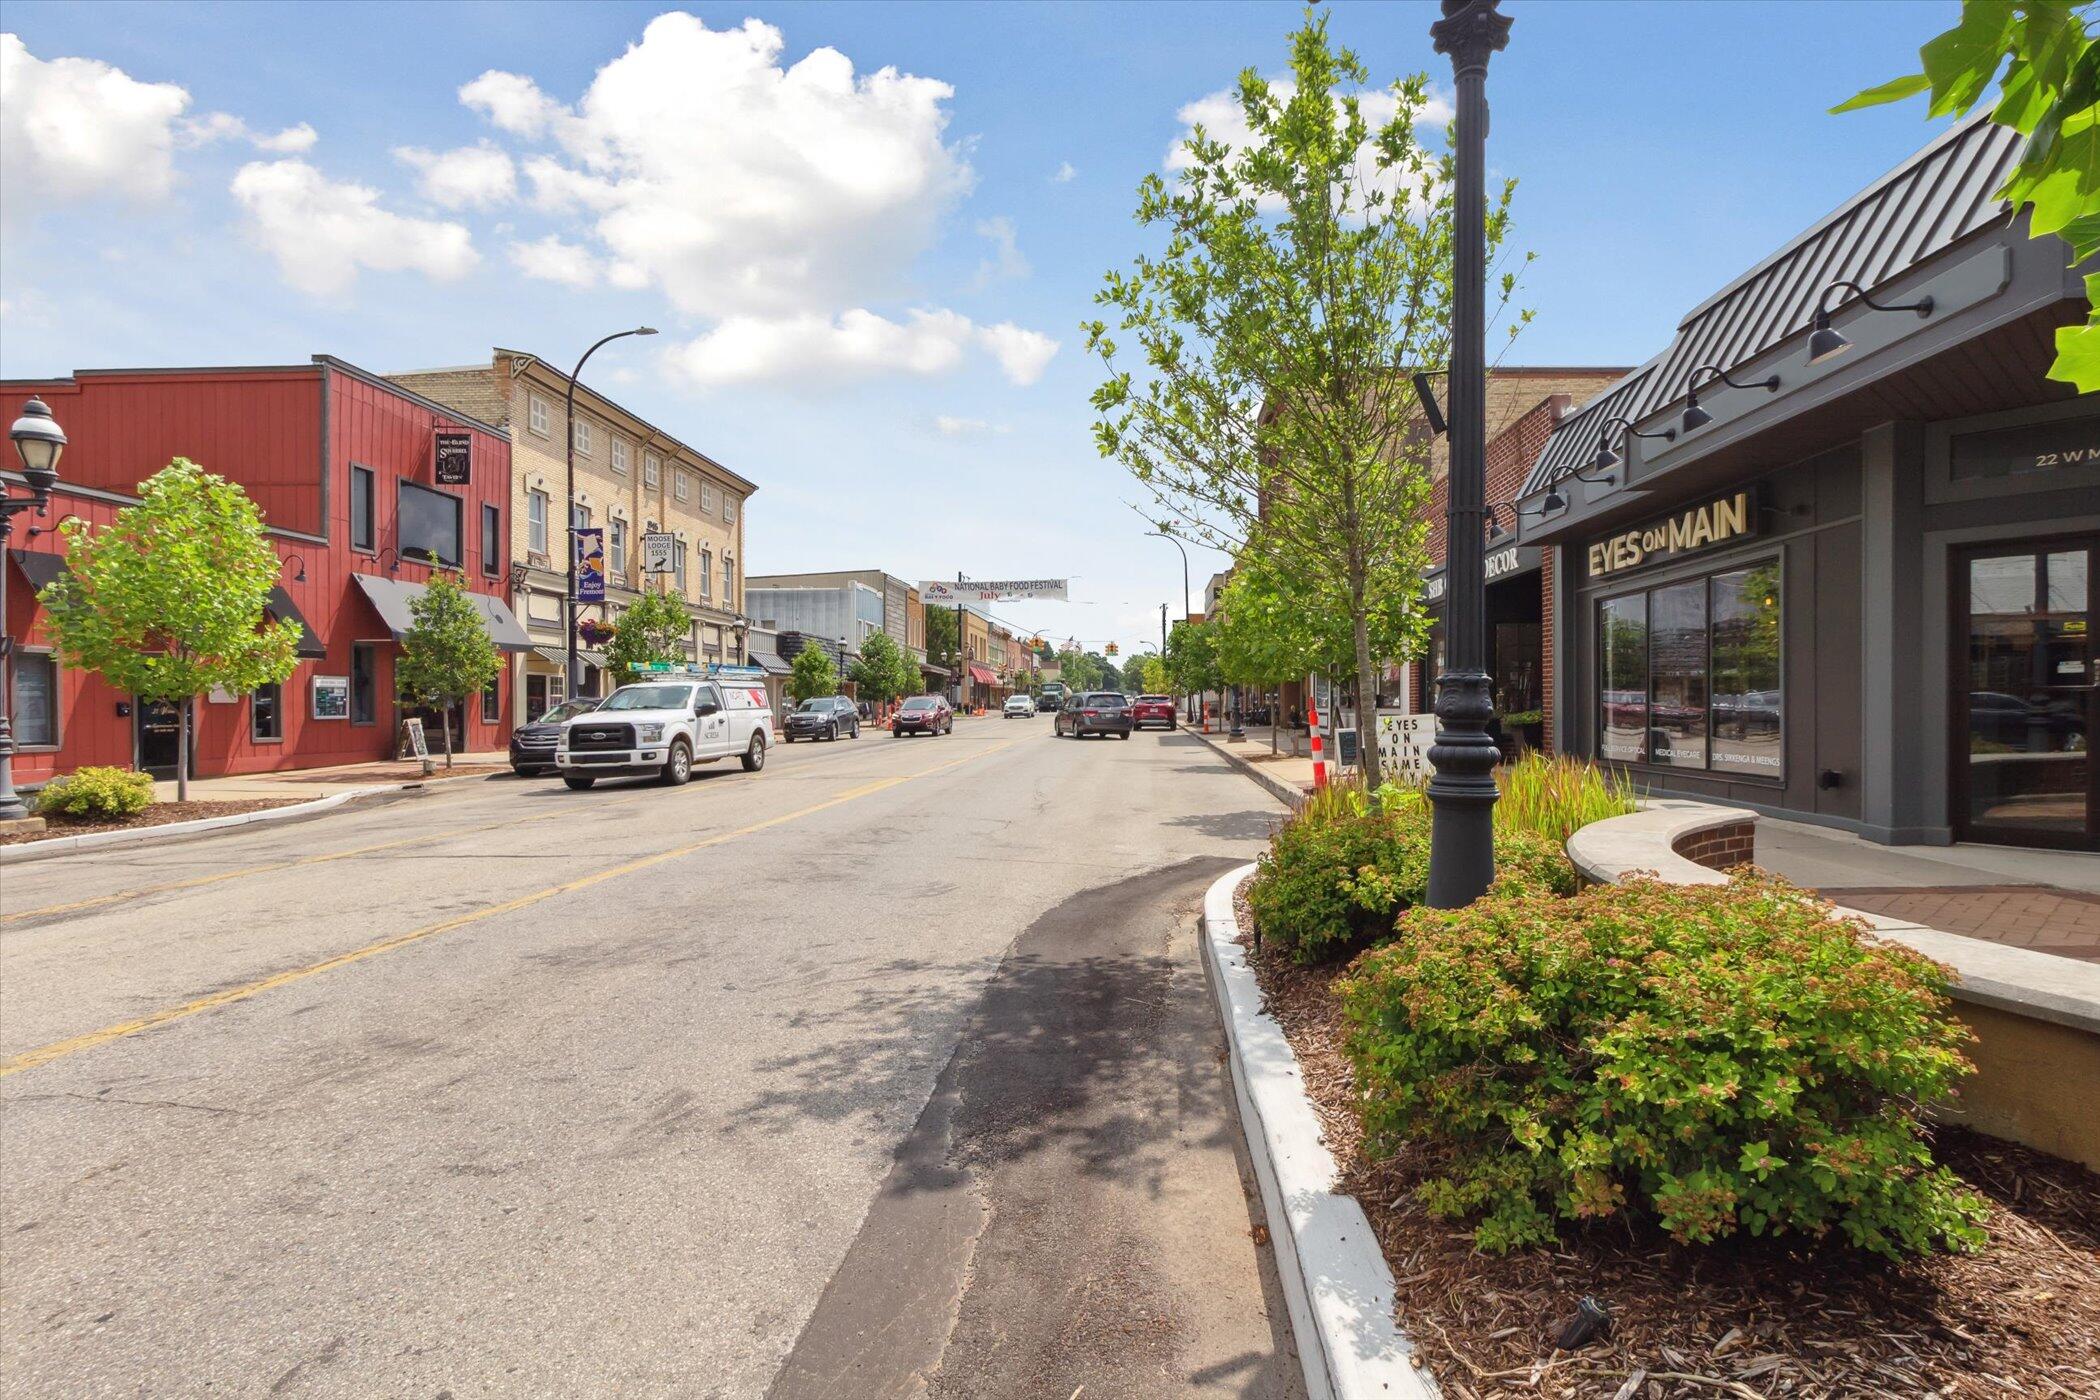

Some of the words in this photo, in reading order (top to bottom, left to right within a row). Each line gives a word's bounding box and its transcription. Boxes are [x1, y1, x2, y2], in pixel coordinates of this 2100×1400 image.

[2035, 453, 2058, 467] 22
[2063, 449, 2084, 463] W
[1588, 530, 1643, 577] EYES
[1642, 525, 1666, 553] ON
[1668, 492, 1747, 554] MAIN
[583, 581, 602, 589] Enjoy
[954, 582, 989, 592] NATIONAL
[990, 581, 1008, 591] BABY
[1009, 581, 1028, 590] FOOD
[1029, 580, 1063, 590] FESTIVAL
[979, 591, 1001, 601] July
[1387, 719, 1418, 731] EYES
[1392, 733, 1410, 744] ON
[1378, 746, 1420, 757] MAIN
[1655, 748, 1676, 757] MEDICAL
[1677, 749, 1700, 759] EYECARE
[1381, 759, 1420, 770] SAME
[1751, 755, 1756, 763] &
